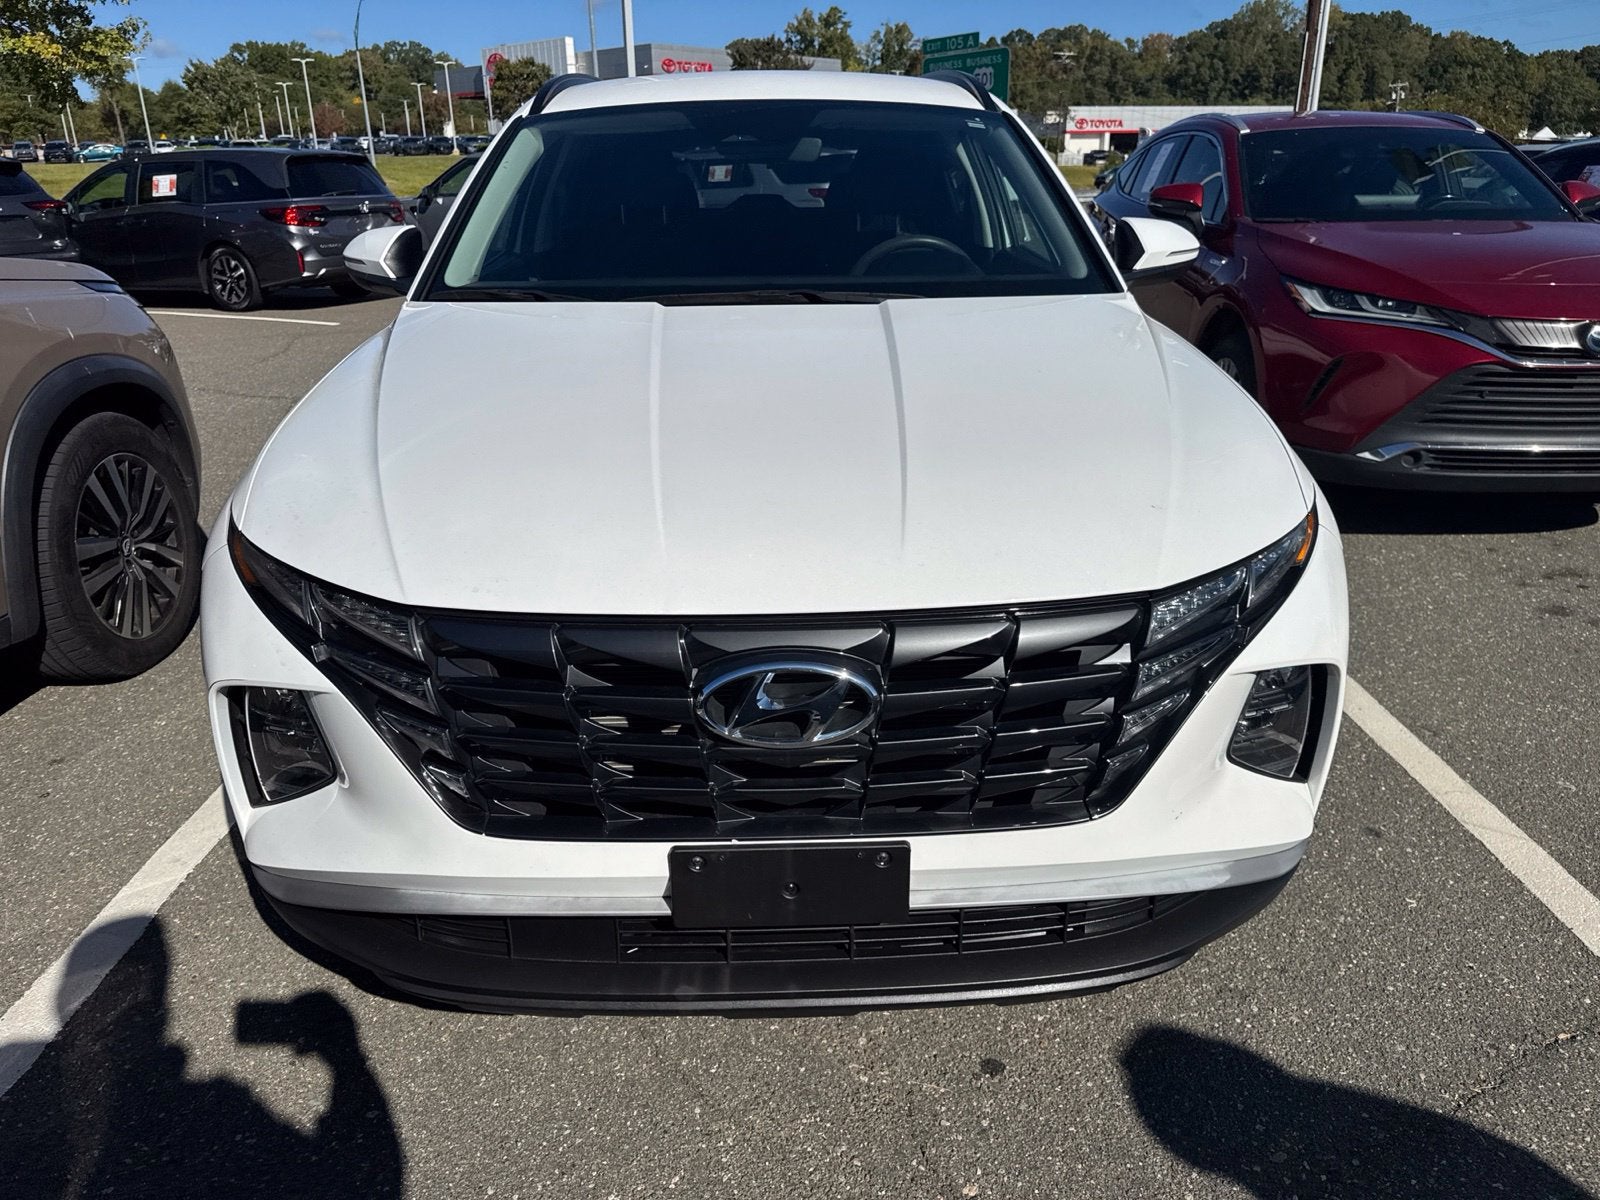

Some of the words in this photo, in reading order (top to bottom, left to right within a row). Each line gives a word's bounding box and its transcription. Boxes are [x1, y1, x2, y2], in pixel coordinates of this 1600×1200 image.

[946, 37, 963, 50] 105
[967, 35, 974, 47] A
[676, 61, 713, 73] TOYOTA
[966, 55, 1002, 67] BUSINESS
[1089, 119, 1123, 128] TOYOTA
